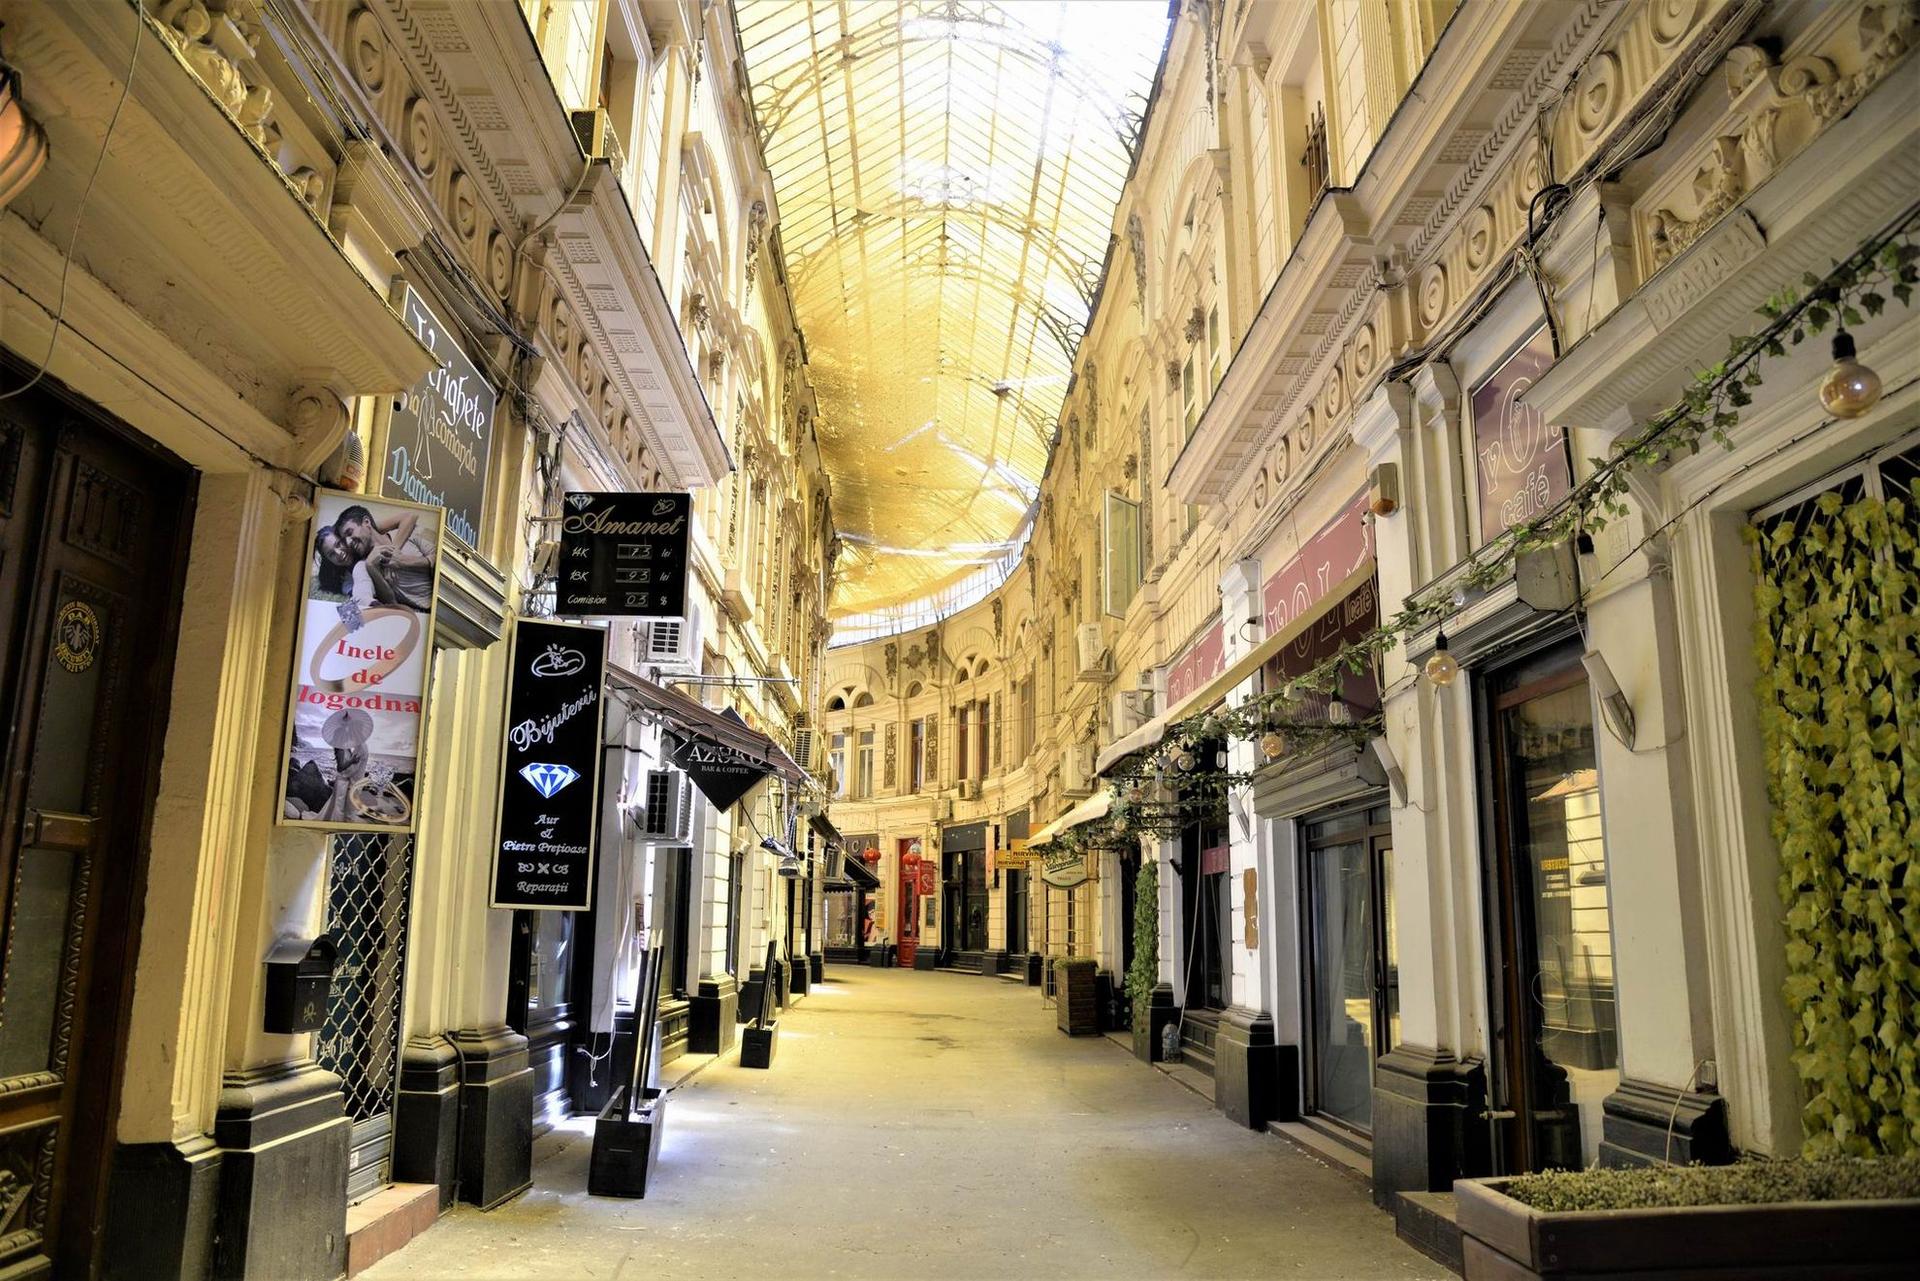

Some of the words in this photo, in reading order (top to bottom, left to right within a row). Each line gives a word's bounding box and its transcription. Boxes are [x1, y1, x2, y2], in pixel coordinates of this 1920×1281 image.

[1500, 464, 1550, 529] café
[563, 504, 686, 535] Amanet
[572, 546, 590, 558] 14K
[661, 546, 673, 558] lei
[570, 569, 590, 582] 18K
[660, 571, 671, 582] lei
[336, 639, 396, 661] Inele
[351, 668, 384, 685] de
[298, 684, 421, 714] logodna
[510, 684, 597, 752] Bijuterii
[701, 765, 715, 773] BAR
[722, 767, 749, 775] COFFEE
[534, 814, 560, 825] Aur
[540, 827, 554, 839] &
[502, 840, 536, 852] Pietre
